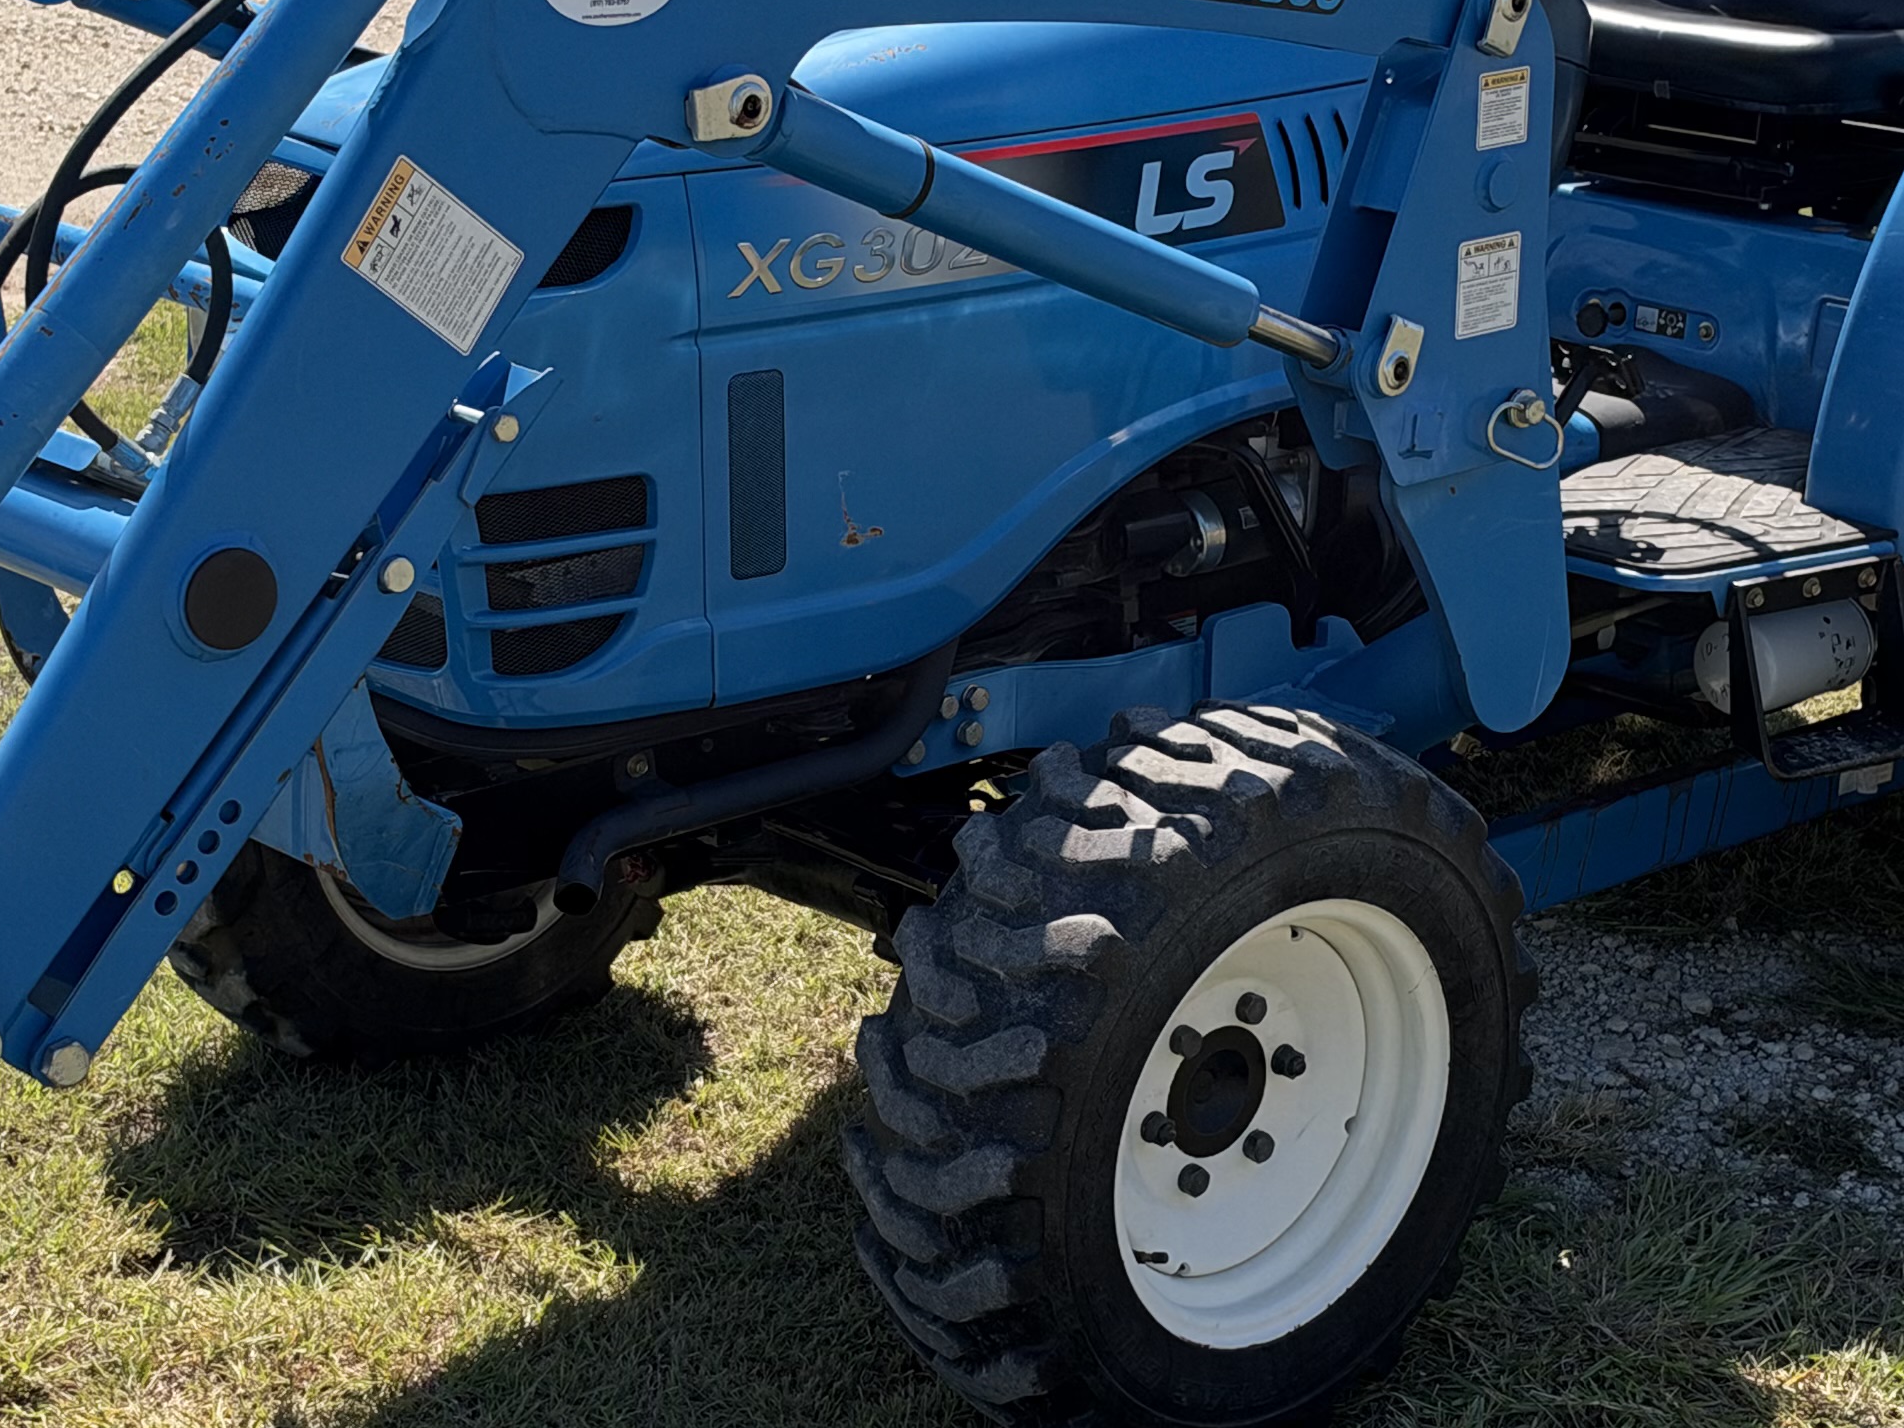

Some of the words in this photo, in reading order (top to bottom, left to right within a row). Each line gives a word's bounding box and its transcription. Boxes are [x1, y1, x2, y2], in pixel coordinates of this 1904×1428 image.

[363, 173, 405, 237] WARNING
[1135, 150, 1235, 235] LS
[1473, 240, 1507, 254] WARNING
